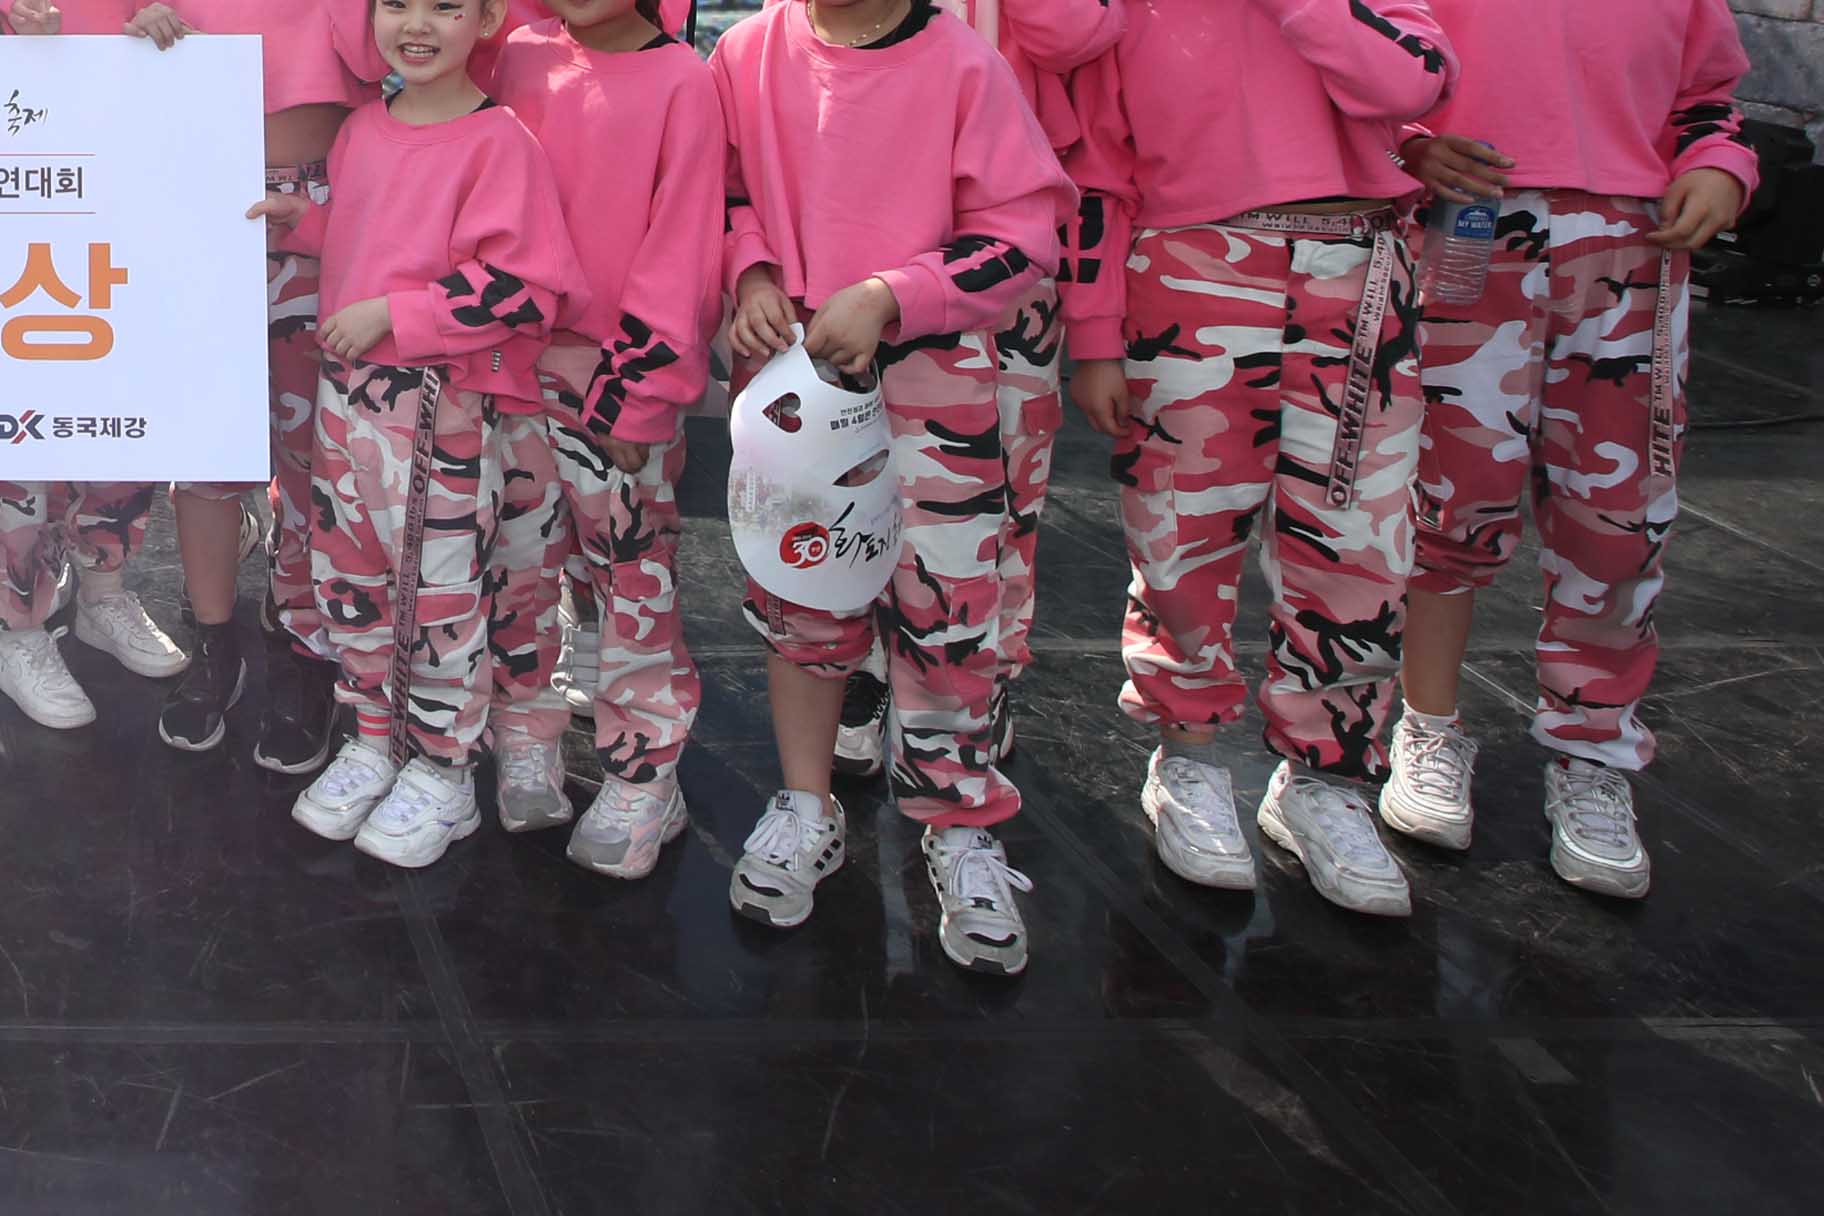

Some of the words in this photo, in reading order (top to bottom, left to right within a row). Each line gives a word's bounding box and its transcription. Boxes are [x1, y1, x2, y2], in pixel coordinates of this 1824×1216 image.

[52, 416, 146, 439] 동국제강
[413, 370, 439, 495] OFF-WHI
[1331, 345, 1373, 505] OFF-WHITE
[789, 536, 827, 566] 30
[392, 634, 409, 761] FF-WHITE
